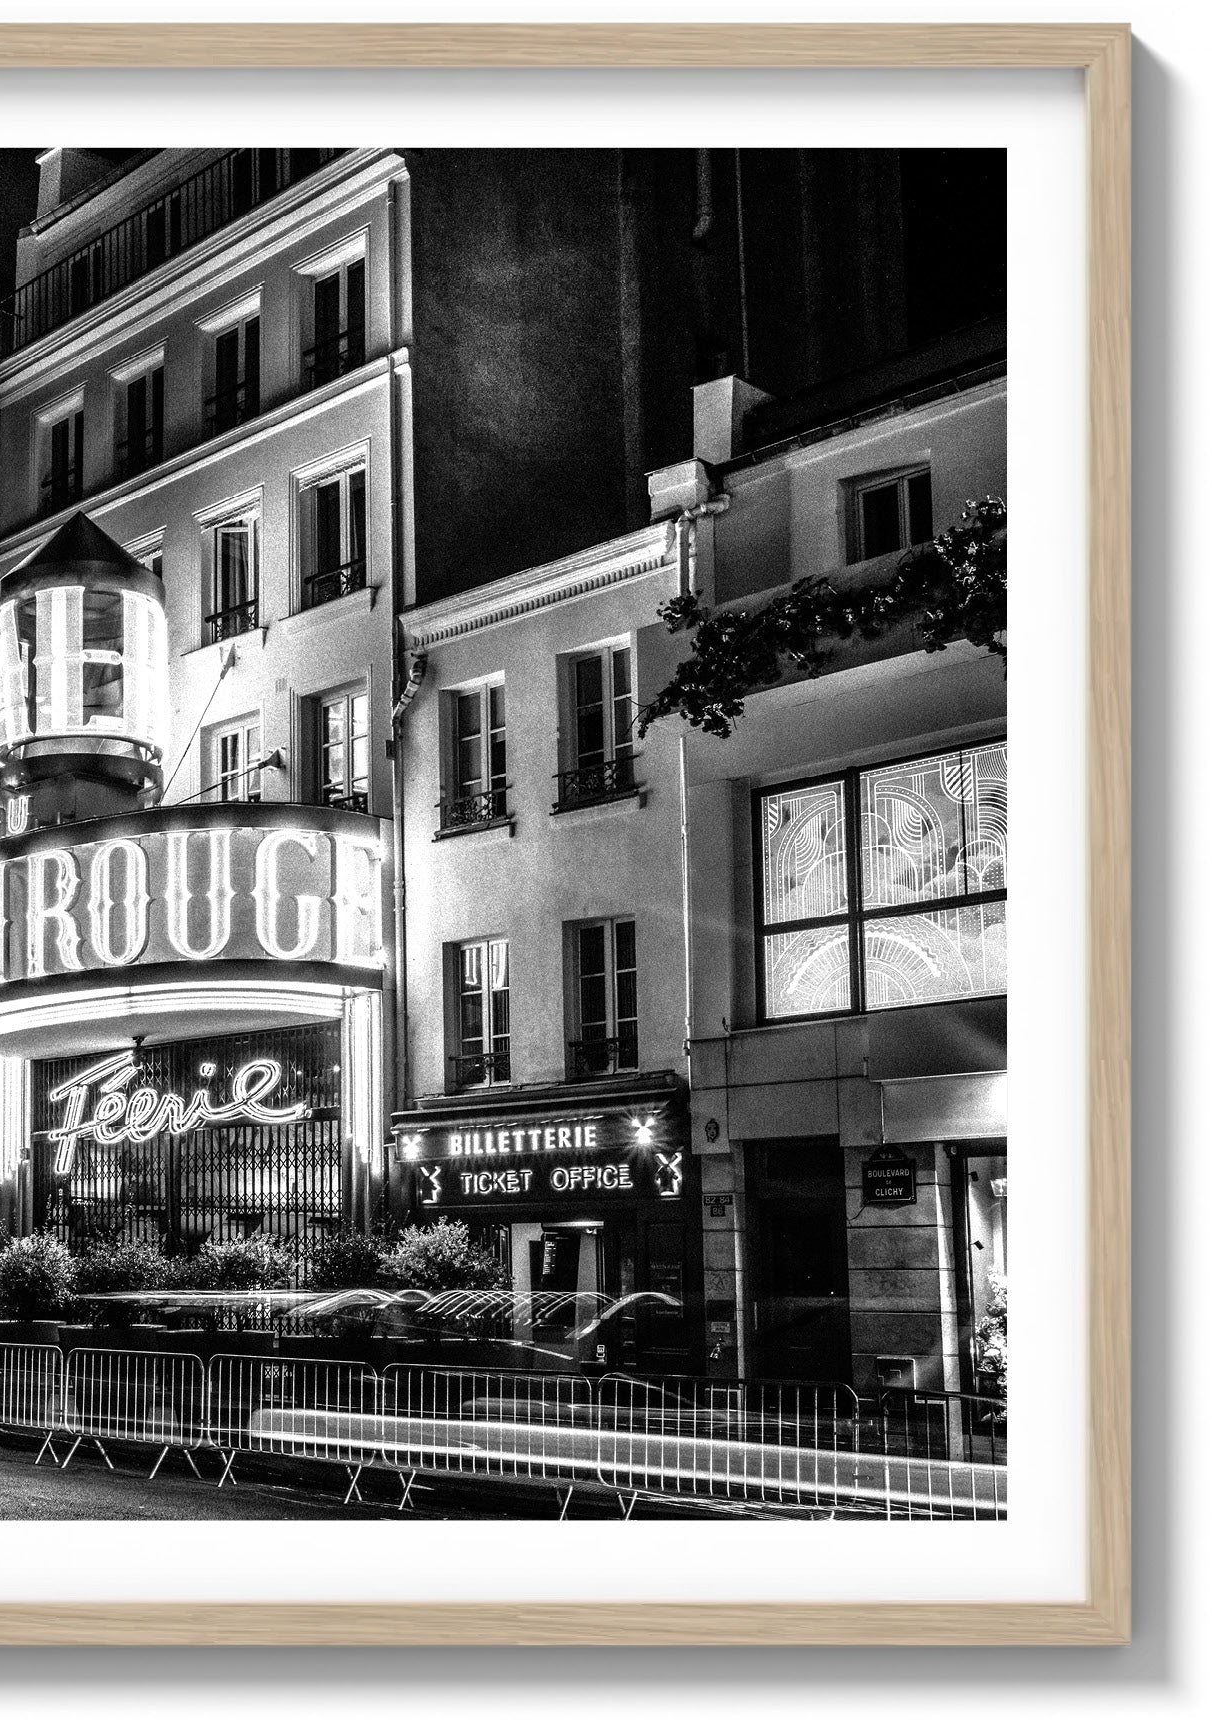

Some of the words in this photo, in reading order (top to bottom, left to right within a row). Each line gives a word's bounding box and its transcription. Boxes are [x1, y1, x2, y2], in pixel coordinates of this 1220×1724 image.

[26, 827, 385, 970] ROUGE
[451, 1126, 597, 1156] BILLETTERIE
[867, 1168, 910, 1178] BOULEVARD
[460, 1170, 532, 1195] TICKET
[550, 1164, 633, 1190] OFFICE
[875, 1187, 904, 1197] CLICHY
[705, 1196, 716, 1204] 82
[719, 1196, 730, 1204] 84
[712, 1207, 724, 1215] 86
